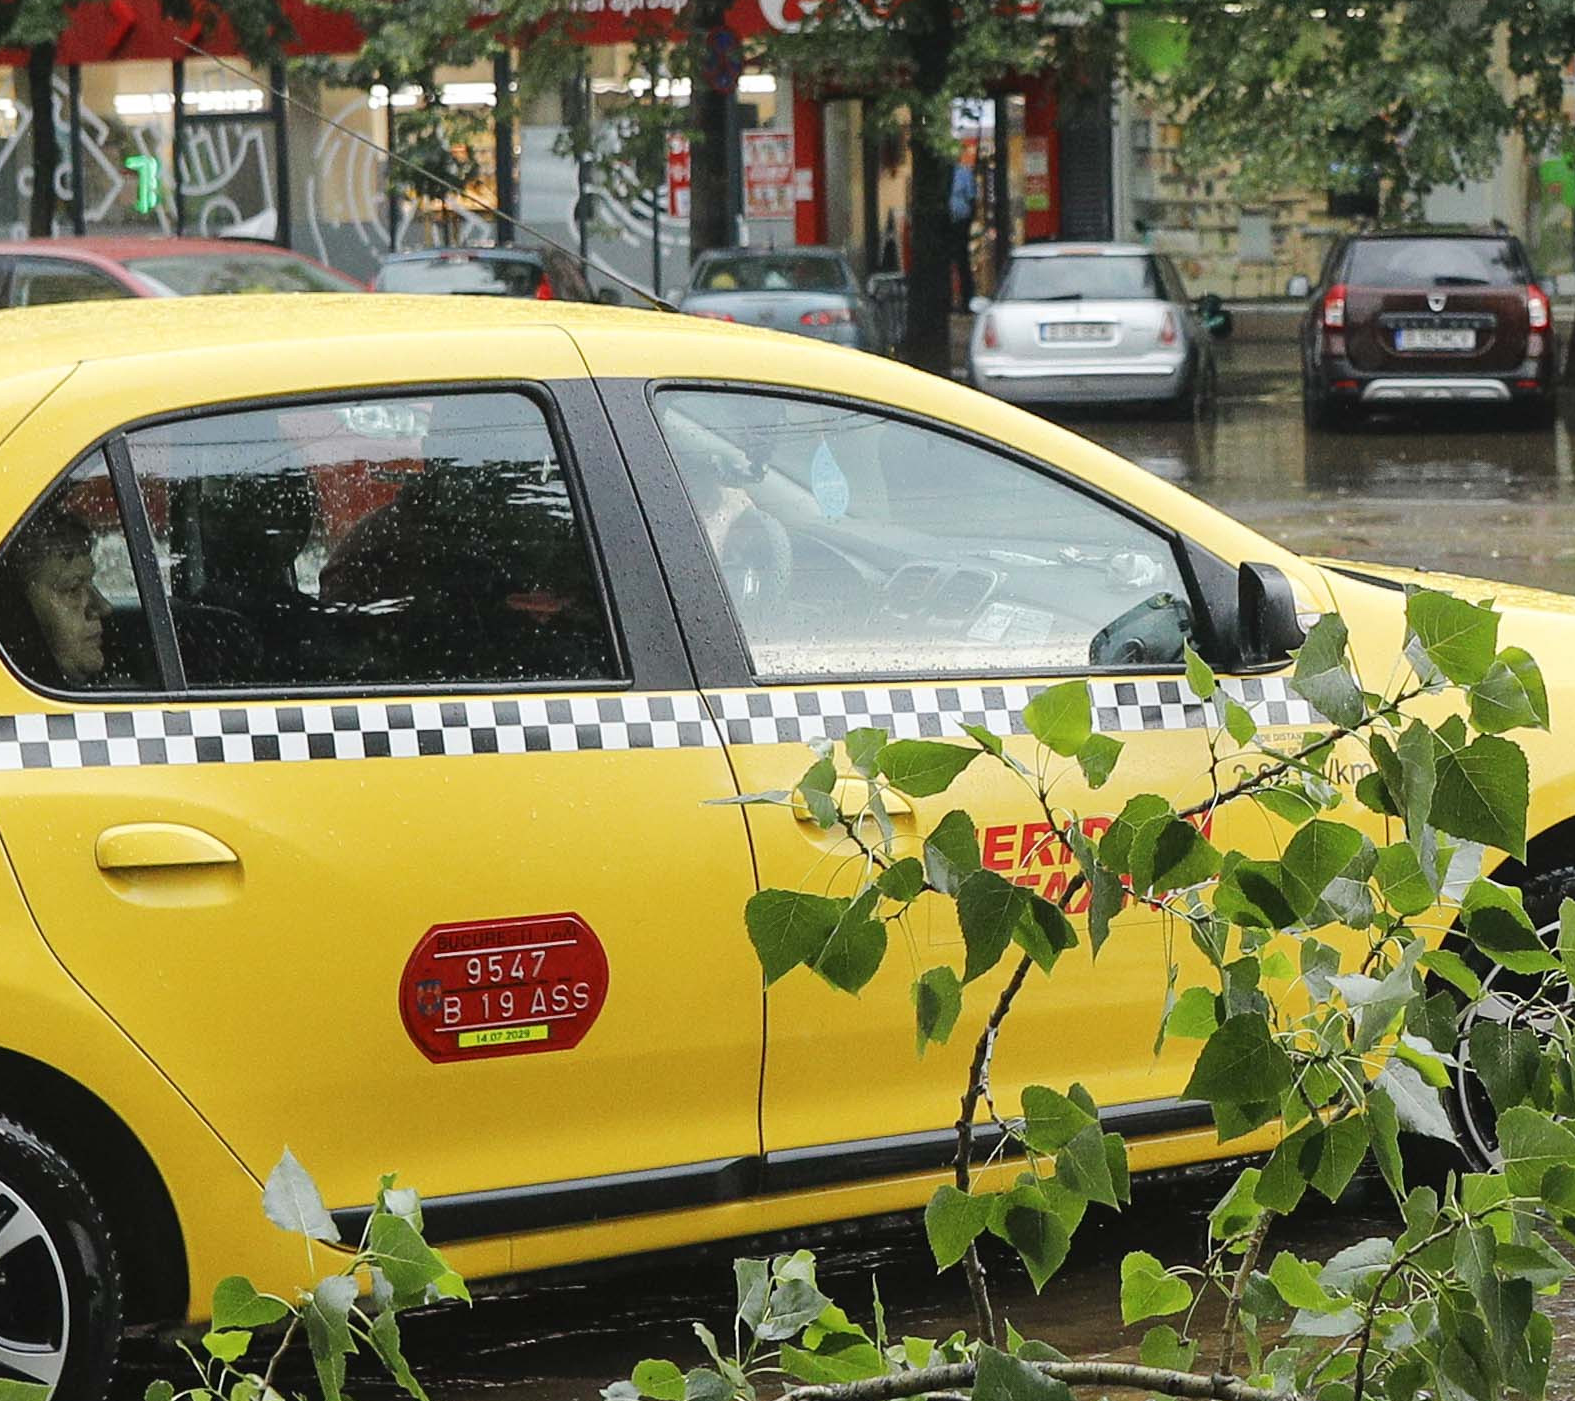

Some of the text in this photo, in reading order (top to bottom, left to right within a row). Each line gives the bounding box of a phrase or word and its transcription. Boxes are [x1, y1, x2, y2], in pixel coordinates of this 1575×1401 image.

[467, 950, 546, 984] 9547
[443, 982, 590, 1024] B 19 ASS
